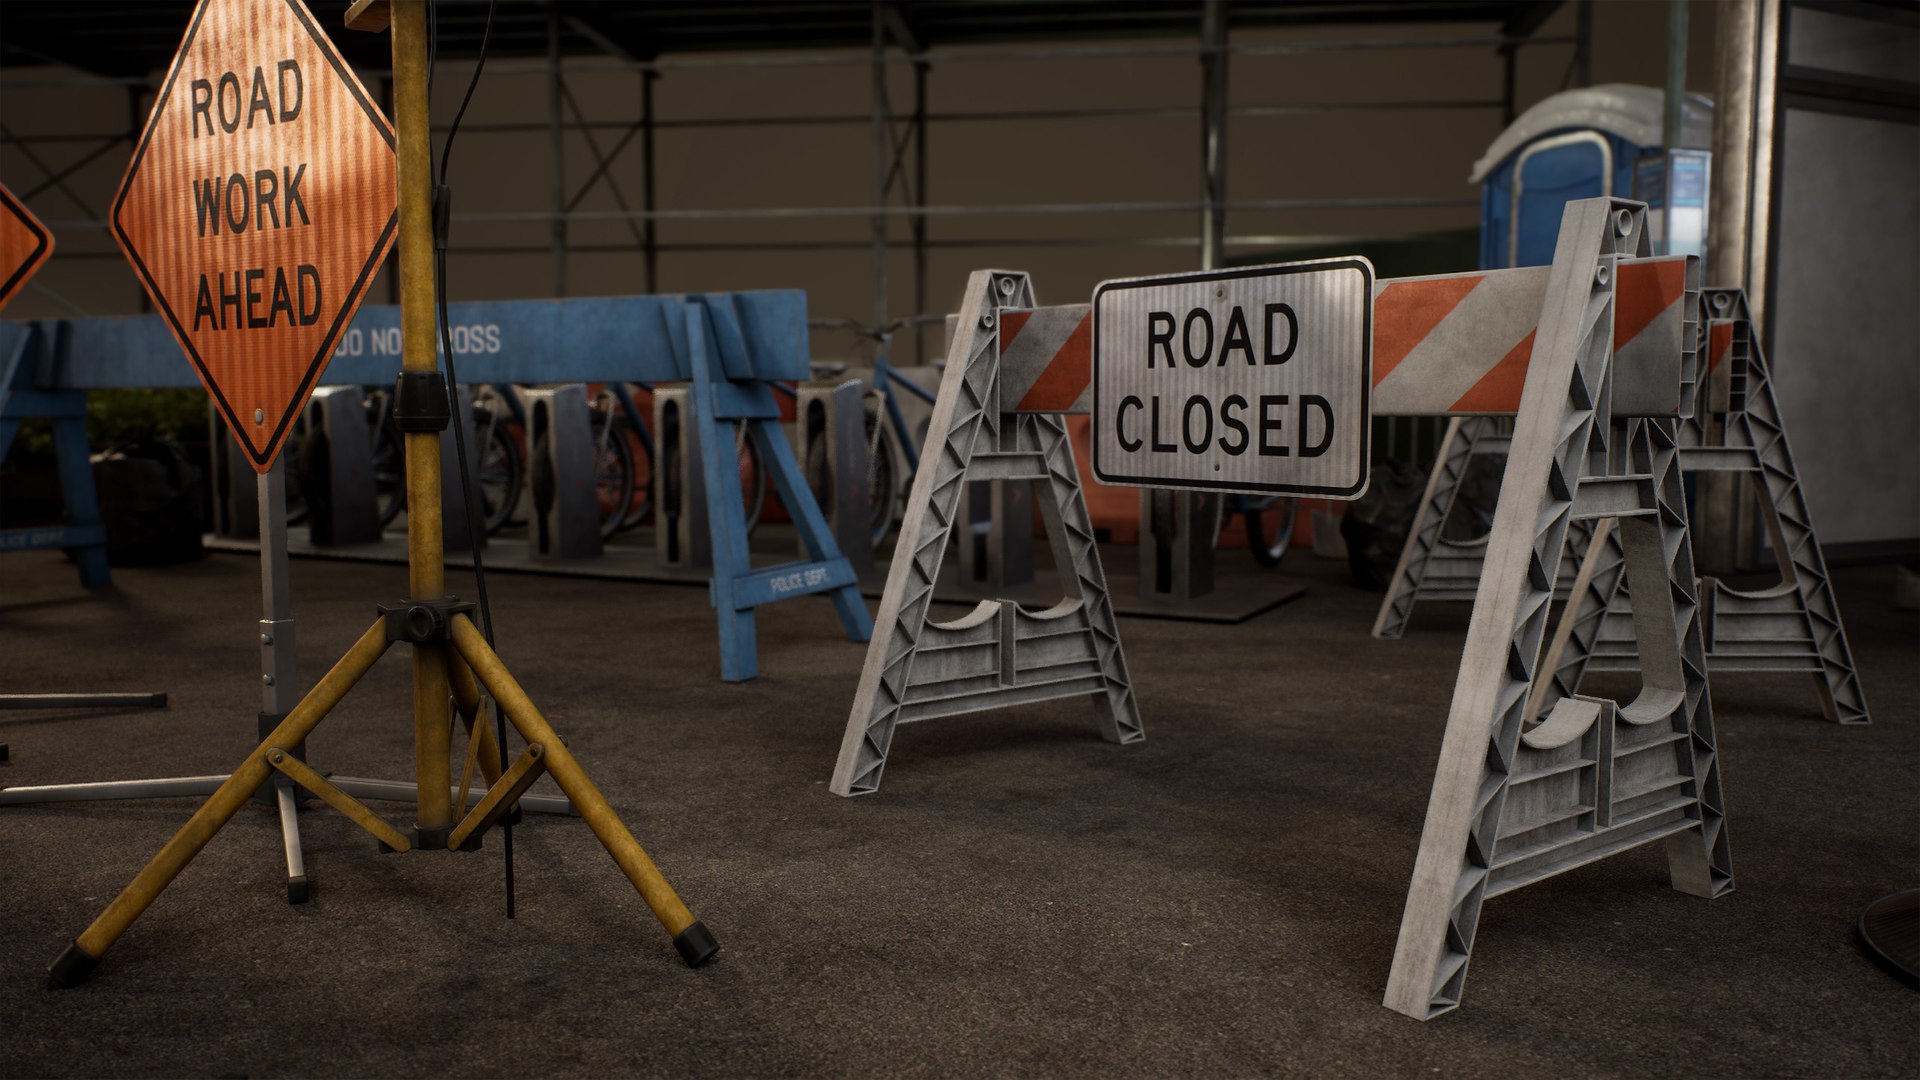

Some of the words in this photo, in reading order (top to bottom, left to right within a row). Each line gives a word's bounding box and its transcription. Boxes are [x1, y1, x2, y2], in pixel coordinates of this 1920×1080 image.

[191, 59, 303, 138] ROAD
[193, 163, 310, 237] WORK
[194, 265, 322, 331] AHEAD
[371, 327, 402, 356] NO
[436, 324, 501, 354] OSS
[1148, 303, 1298, 369] ROAD
[1116, 394, 1334, 458] CLOSED
[770, 572, 804, 593] POLICE
